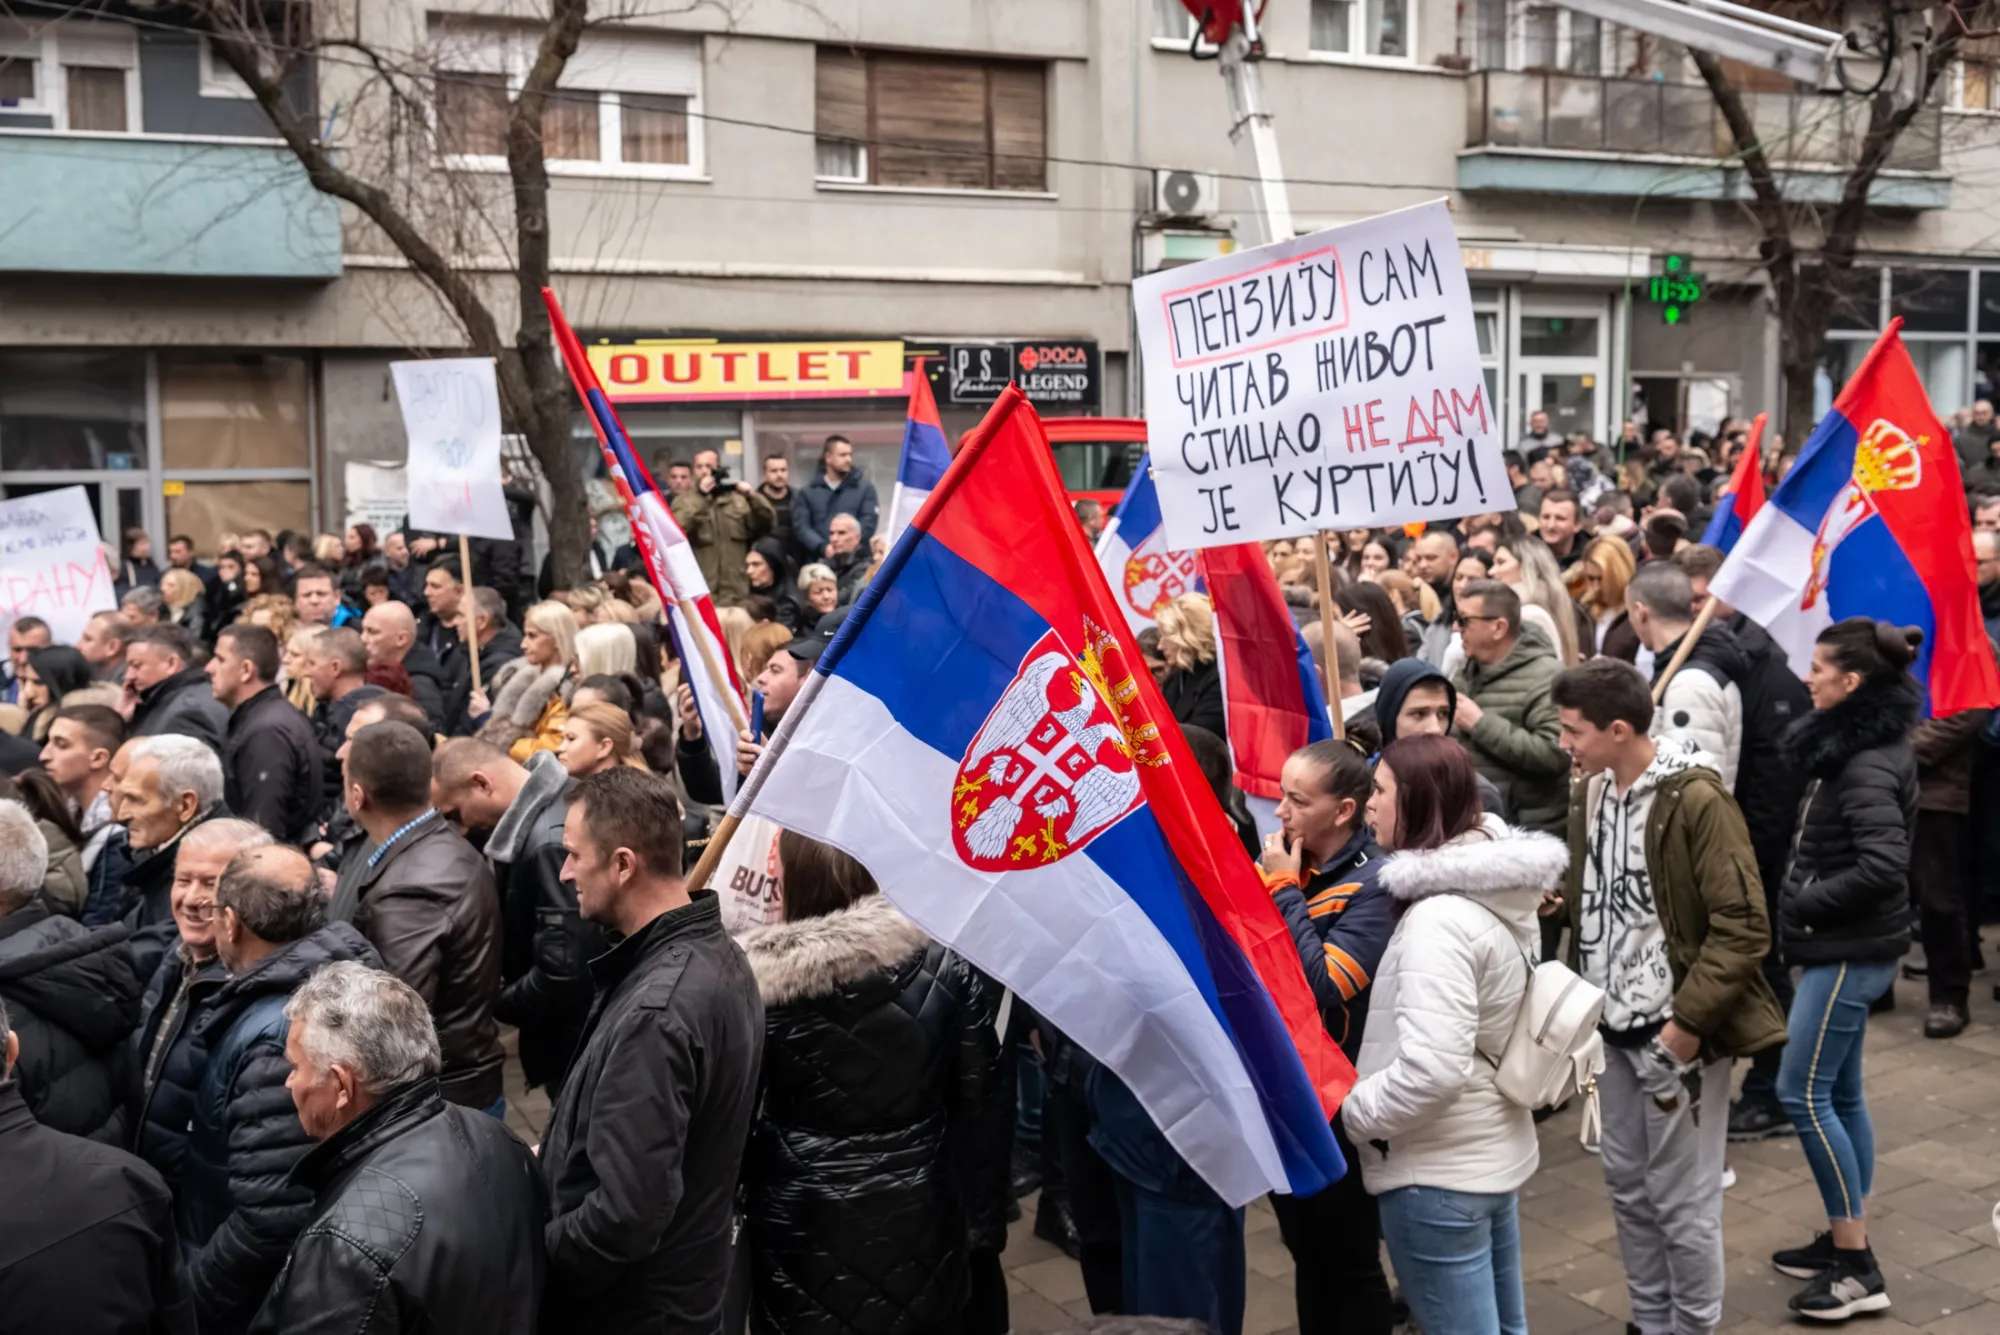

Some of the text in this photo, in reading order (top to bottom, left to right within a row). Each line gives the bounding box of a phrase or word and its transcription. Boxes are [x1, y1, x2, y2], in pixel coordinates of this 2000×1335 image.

[1169, 237, 1443, 359] ПЕНЗИЈУ САМ
[609, 350, 872, 385] OUTLET
[1020, 373, 1089, 391] LEGEND
[1038, 346, 1088, 363] DOCA
[1176, 314, 1447, 427] ЧИТАВ ЖИВОТ
[1181, 384, 1488, 475] СТИЦАО НЕ ДАМ
[1197, 438, 1488, 534] ЈЕ КУРТИЈУ!
